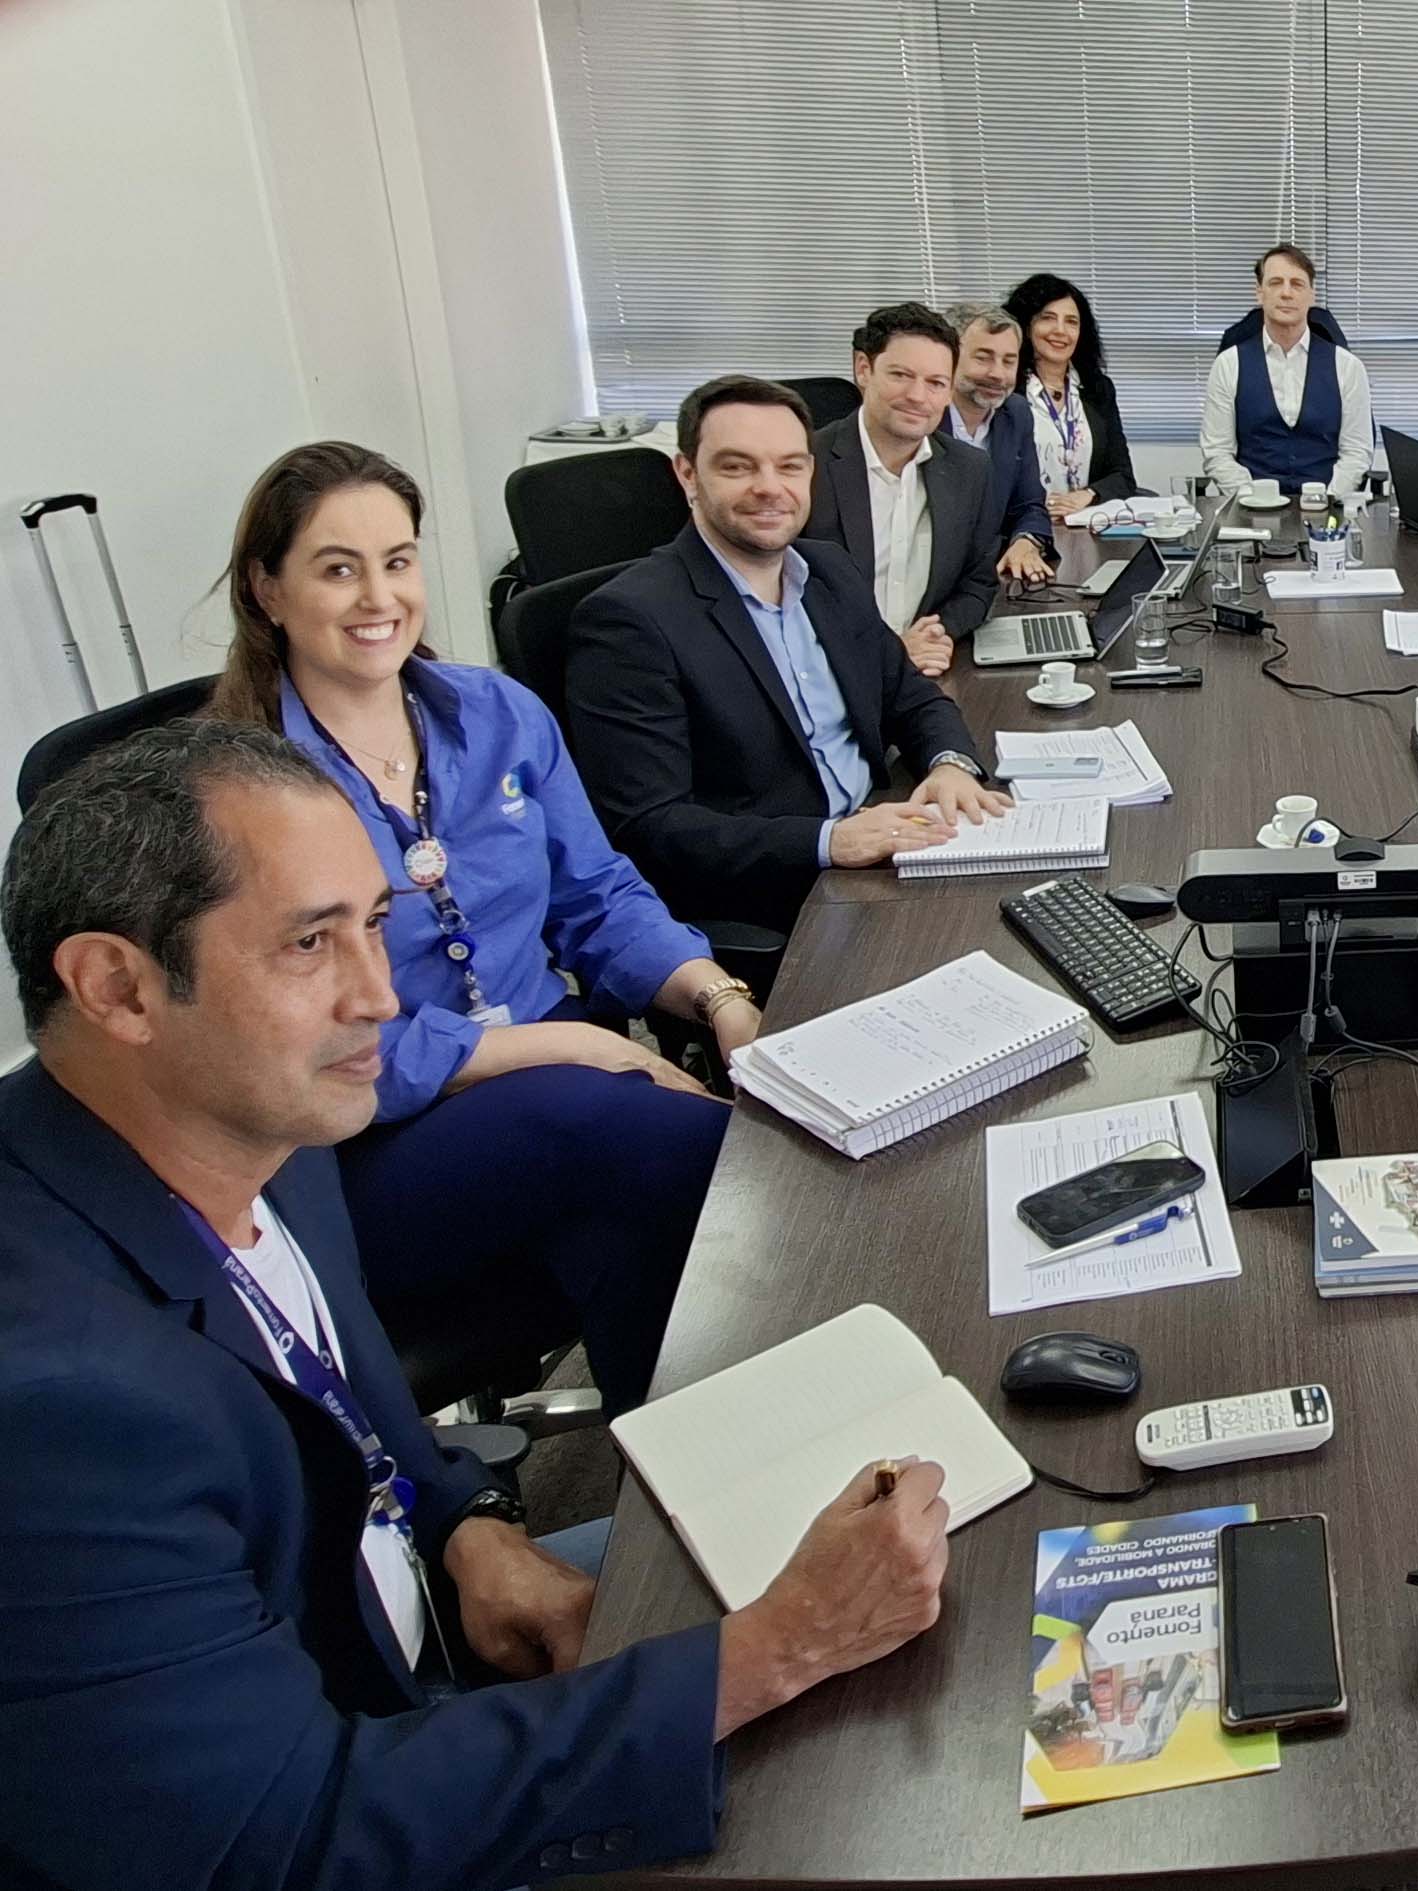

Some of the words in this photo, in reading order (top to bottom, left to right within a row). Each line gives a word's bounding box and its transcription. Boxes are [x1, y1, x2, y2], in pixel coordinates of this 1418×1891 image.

[1086, 1541, 1139, 1555] CIDADES
[1154, 1547, 1164, 1557] A
[1130, 1602, 1201, 1630] Paraná
[1106, 1619, 1202, 1644] Fomento
